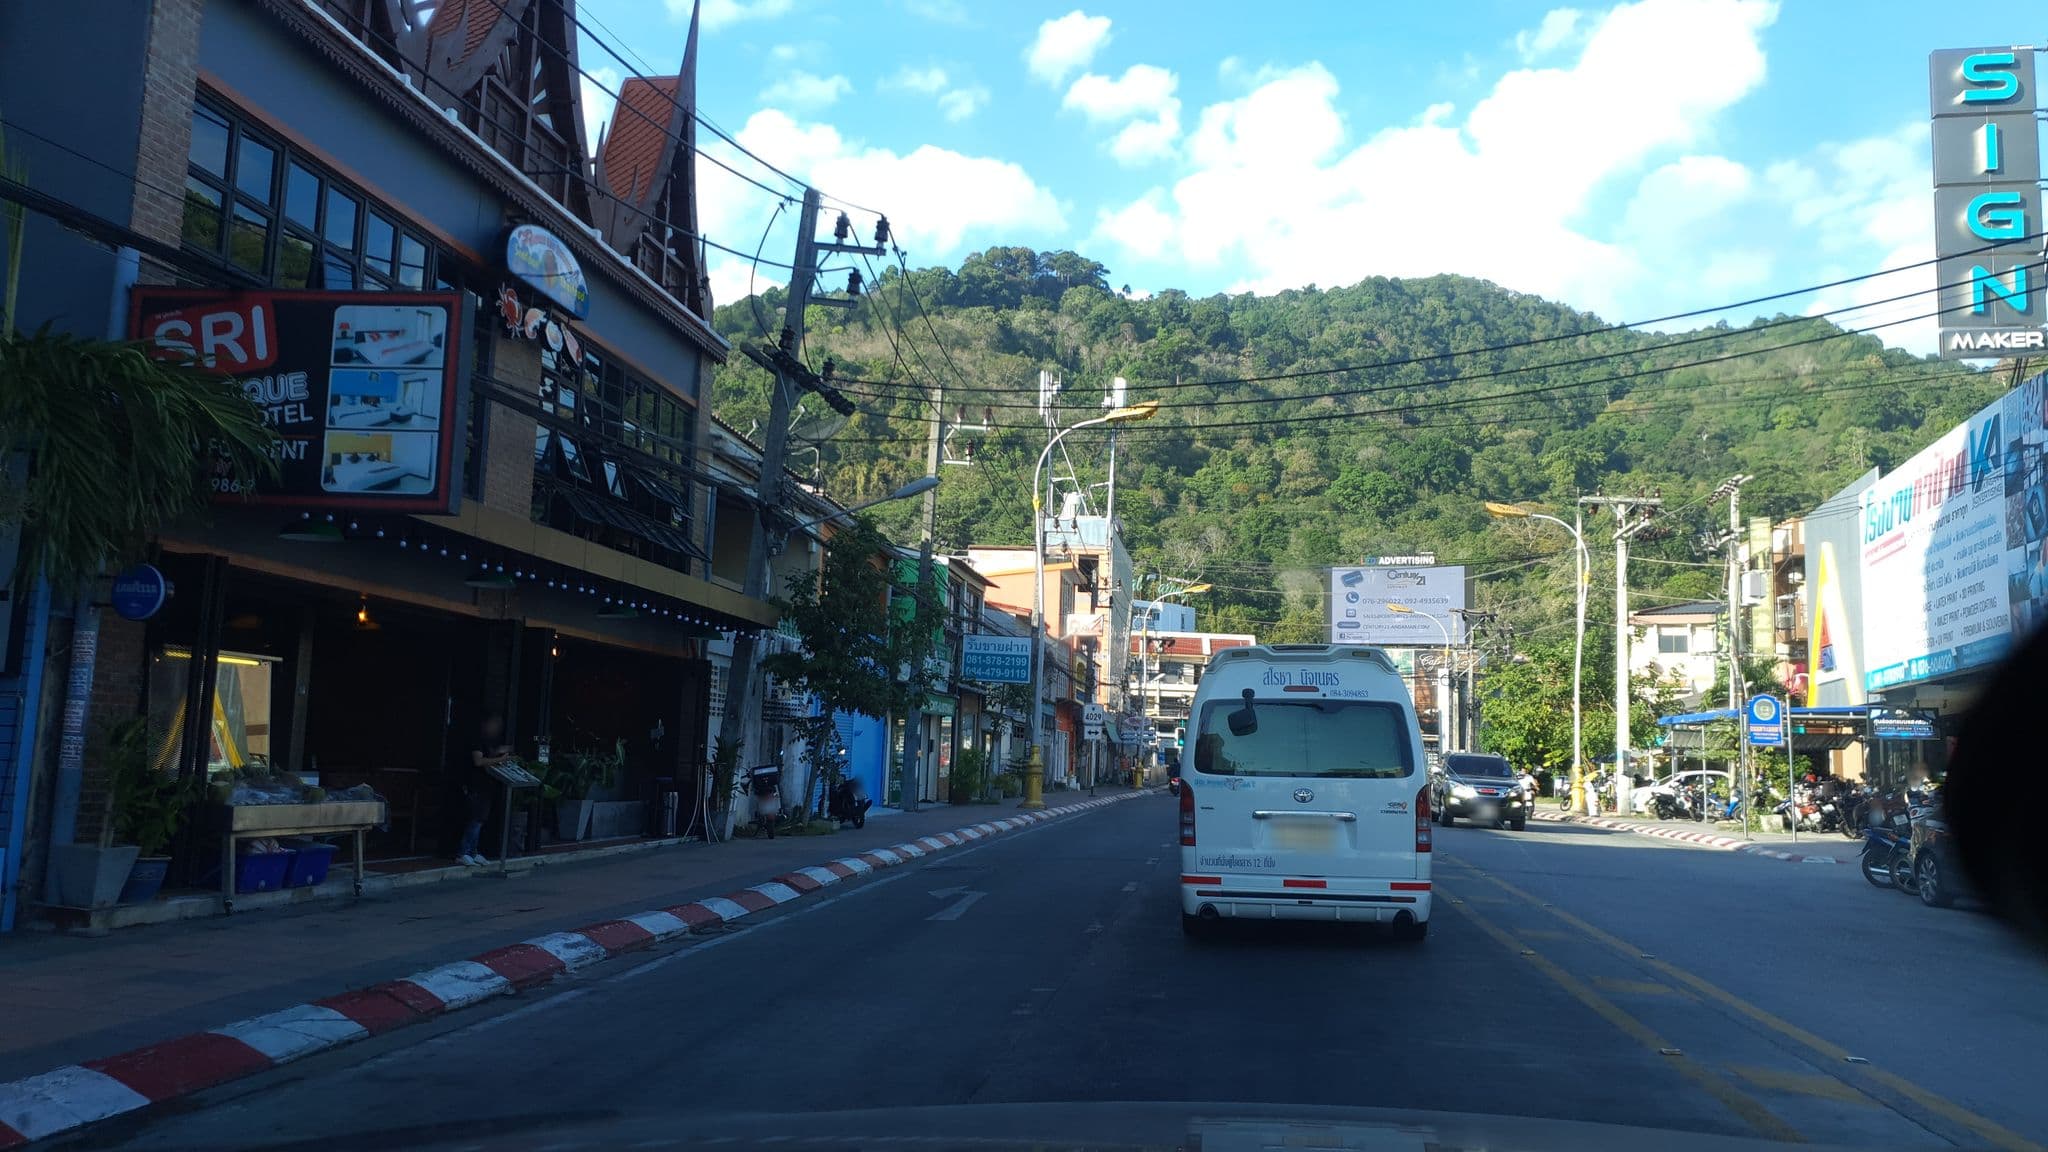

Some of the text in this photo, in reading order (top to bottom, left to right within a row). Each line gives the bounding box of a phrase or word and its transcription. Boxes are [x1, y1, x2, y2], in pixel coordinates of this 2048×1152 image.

[153, 304, 268, 368] SRI
[1950, 331, 2045, 350] MAKER
[1378, 556, 1435, 566] ADVERTISING
[967, 638, 1028, 653] รับขายฝาก
[1085, 712, 1102, 721] 4029
[1253, 857, 1262, 868] 12
